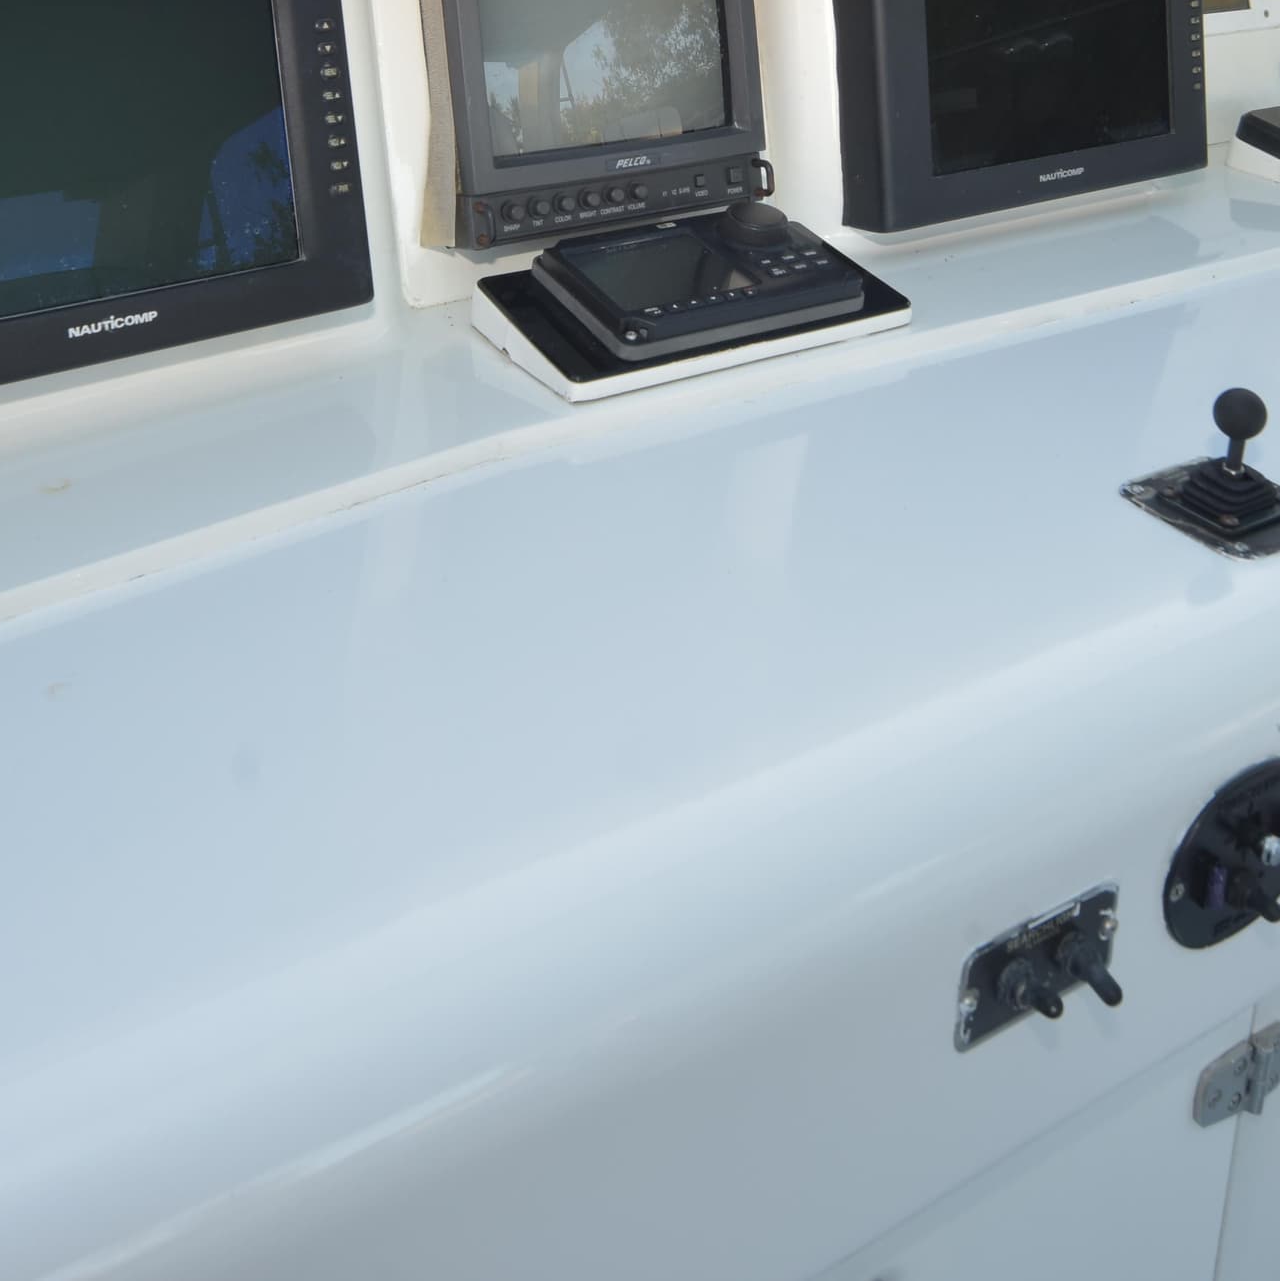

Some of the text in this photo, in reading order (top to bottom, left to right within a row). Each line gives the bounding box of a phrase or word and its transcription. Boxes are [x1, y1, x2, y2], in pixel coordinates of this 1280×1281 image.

[616, 156, 647, 169] PELCO
[600, 206, 625, 216] CONTRAST
[532, 219, 545, 228] TINT
[554, 214, 572, 224] COLOR
